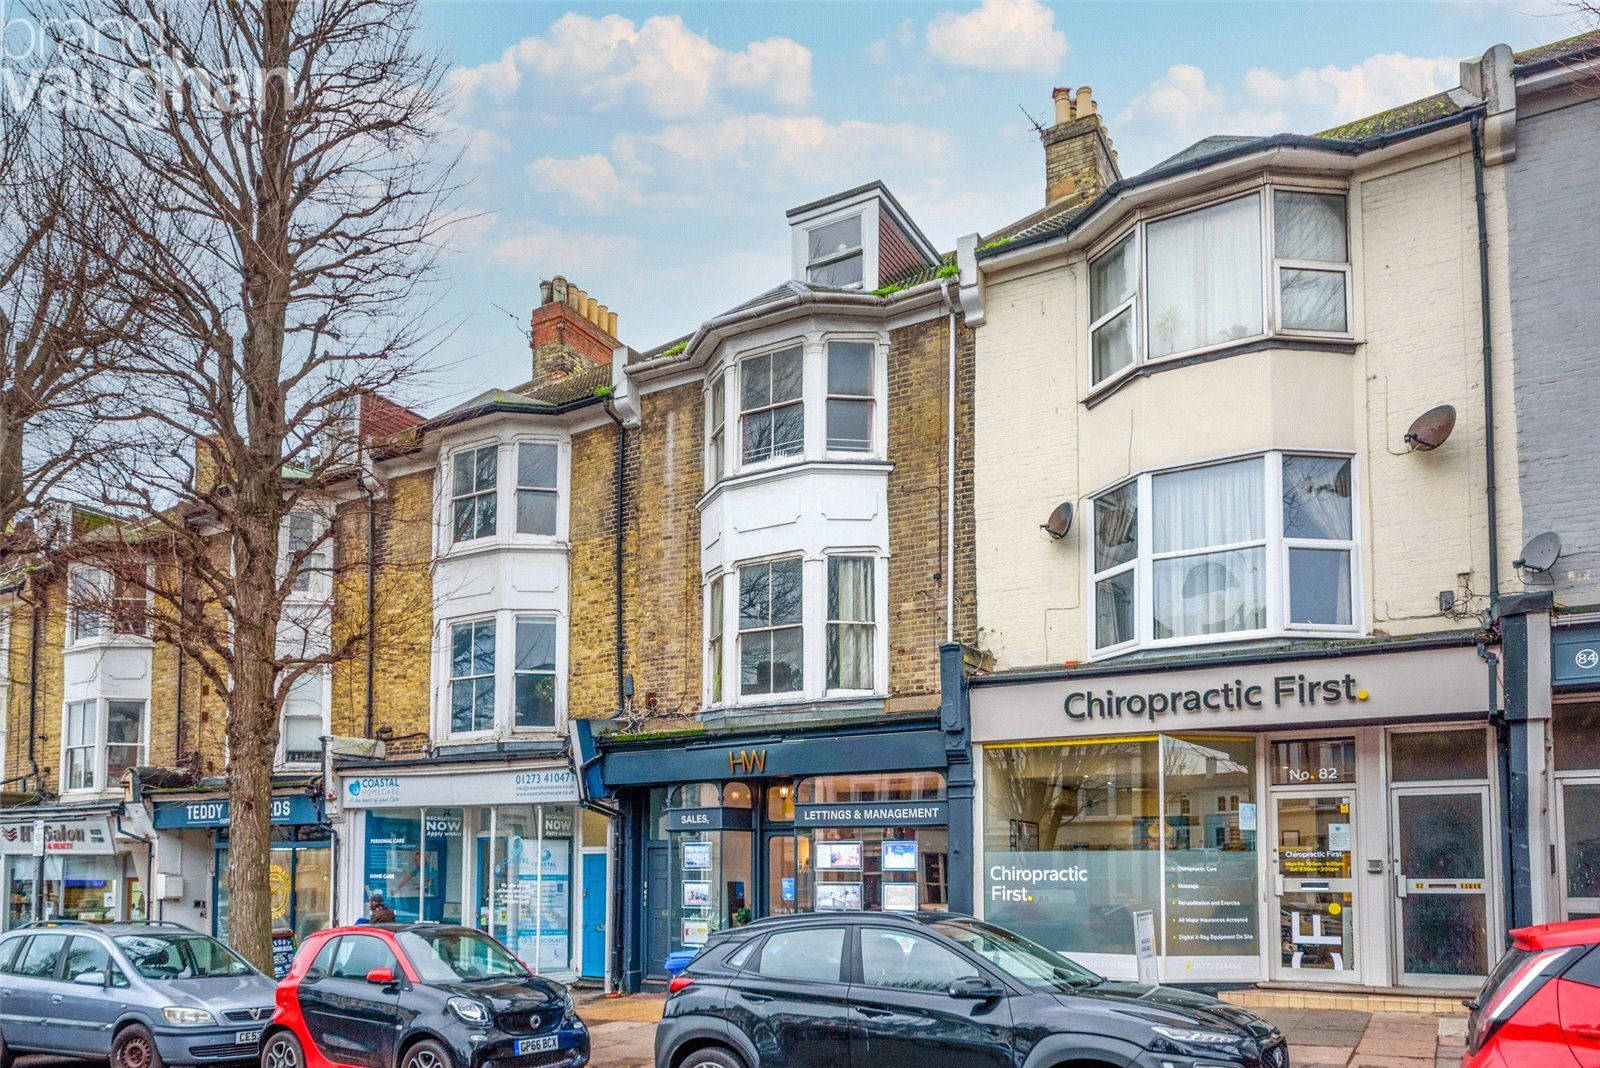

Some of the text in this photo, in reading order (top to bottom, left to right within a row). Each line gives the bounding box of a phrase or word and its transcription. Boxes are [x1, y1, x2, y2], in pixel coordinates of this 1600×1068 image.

[1578, 653, 1597, 664] 84
[1064, 679, 1262, 720] Chiropractic
[728, 749, 767, 774] HW
[515, 774, 541, 784] 01273
[1318, 768, 1338, 779] 82
[362, 778, 399, 788] COASTAL
[187, 804, 223, 820] TEDDY
[804, 807, 939, 820] LETTINGS & MANAGEMENT
[426, 821, 461, 831] NOW
[545, 820, 571, 830] NOW
[43, 825, 85, 842] Salon
[426, 830, 443, 838] Apply
[1285, 850, 1326, 859] Chiropractic
[989, 865, 1088, 884] Chiropractic
[1210, 933, 1236, 941] Equipment
[520, 1037, 557, 1052] GP66 BCX
